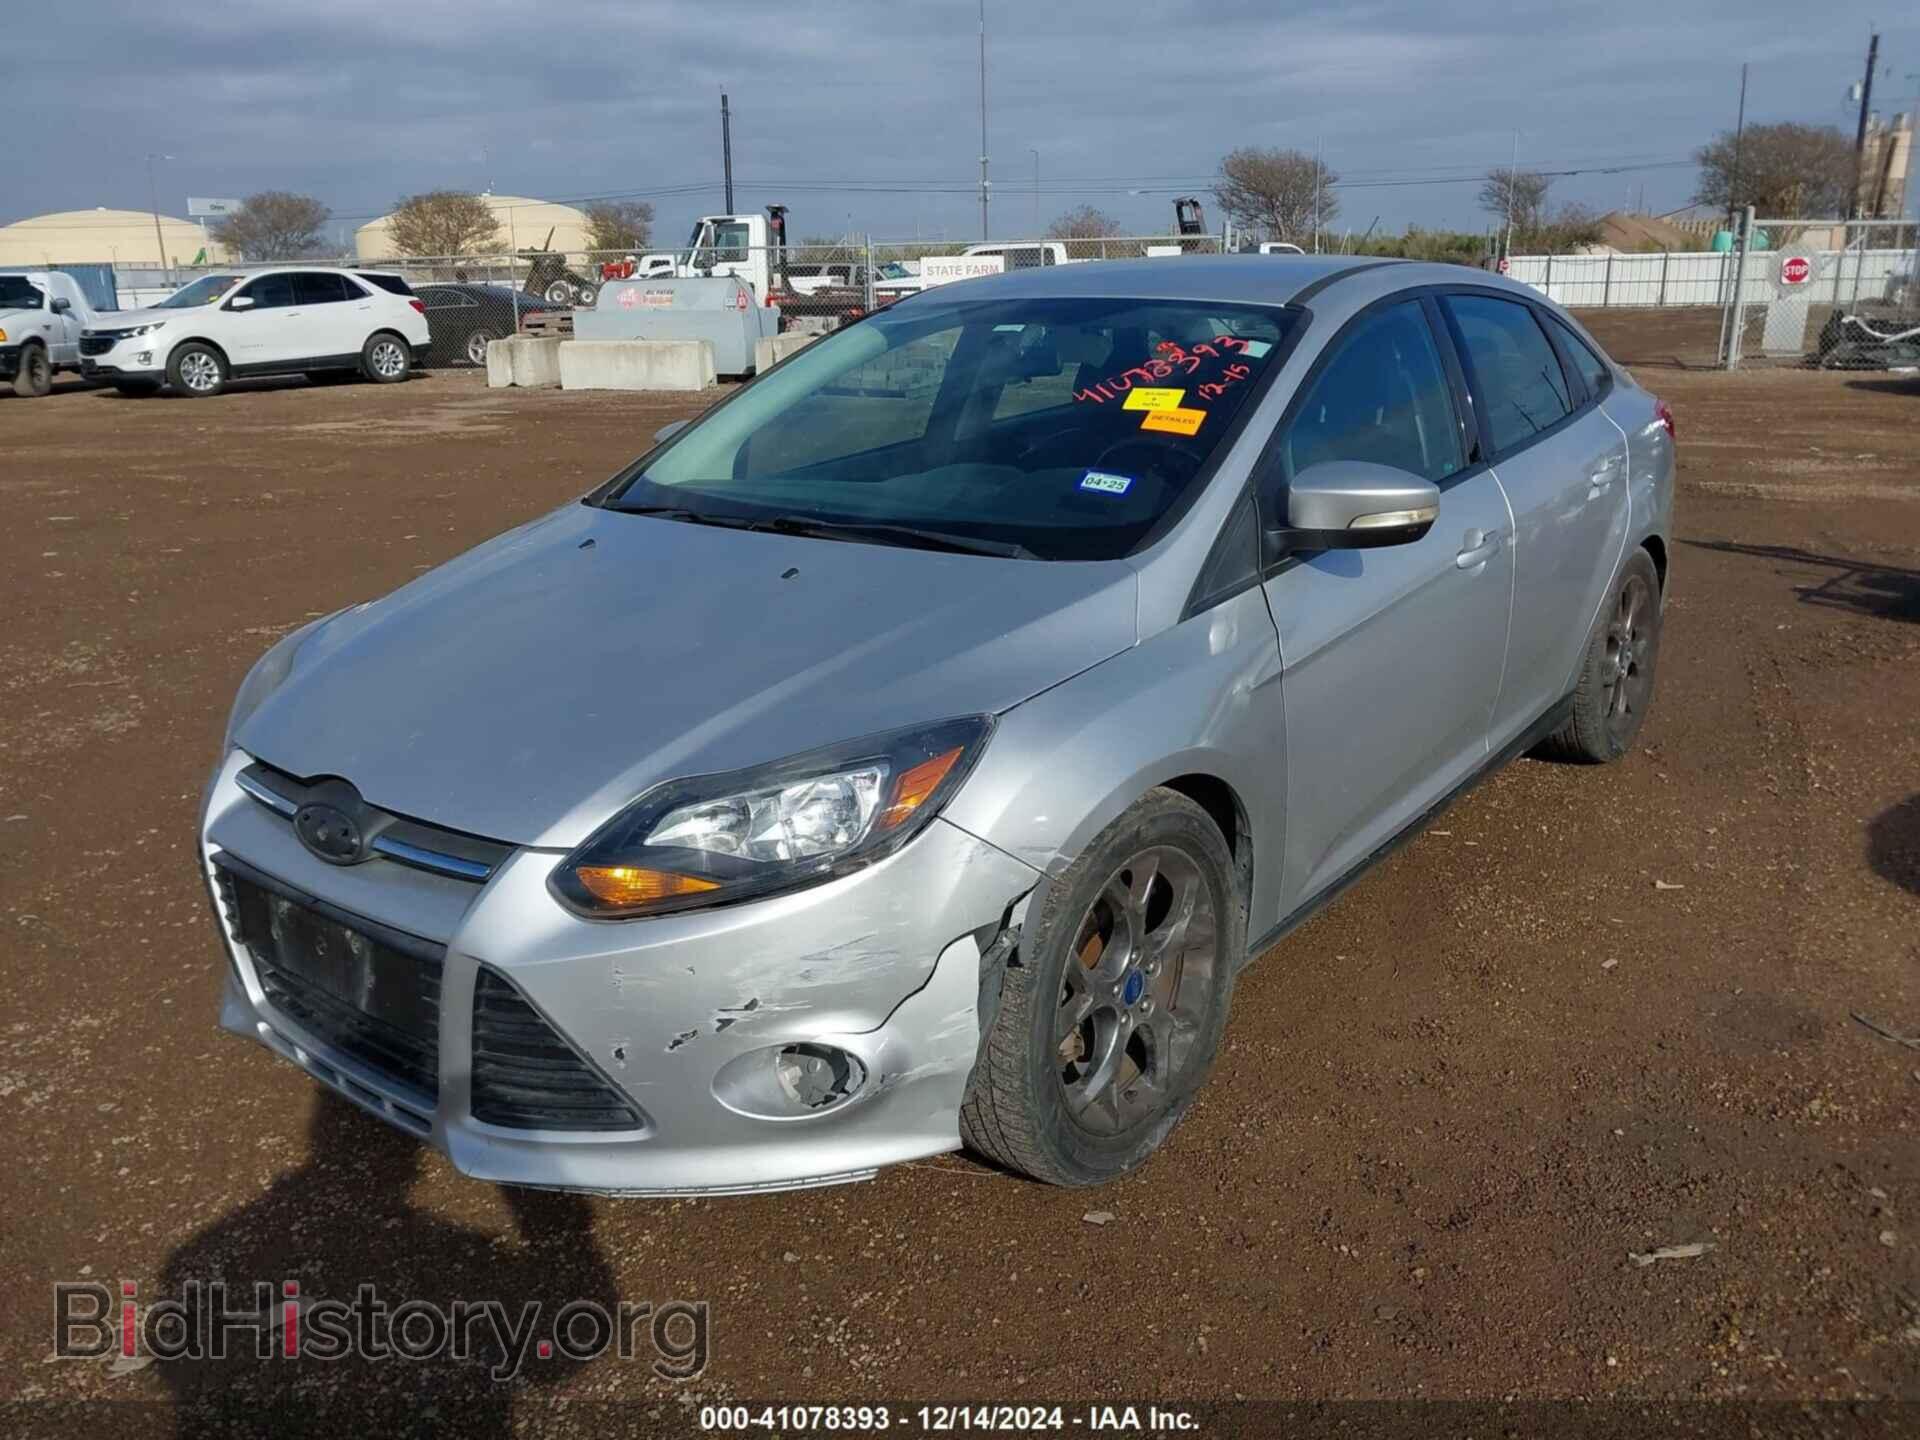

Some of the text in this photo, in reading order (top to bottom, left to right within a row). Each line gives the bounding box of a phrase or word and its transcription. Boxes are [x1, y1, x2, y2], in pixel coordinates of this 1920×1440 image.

[926, 263, 1000, 277] STATE FARM
[1783, 264, 1808, 276] STOP
